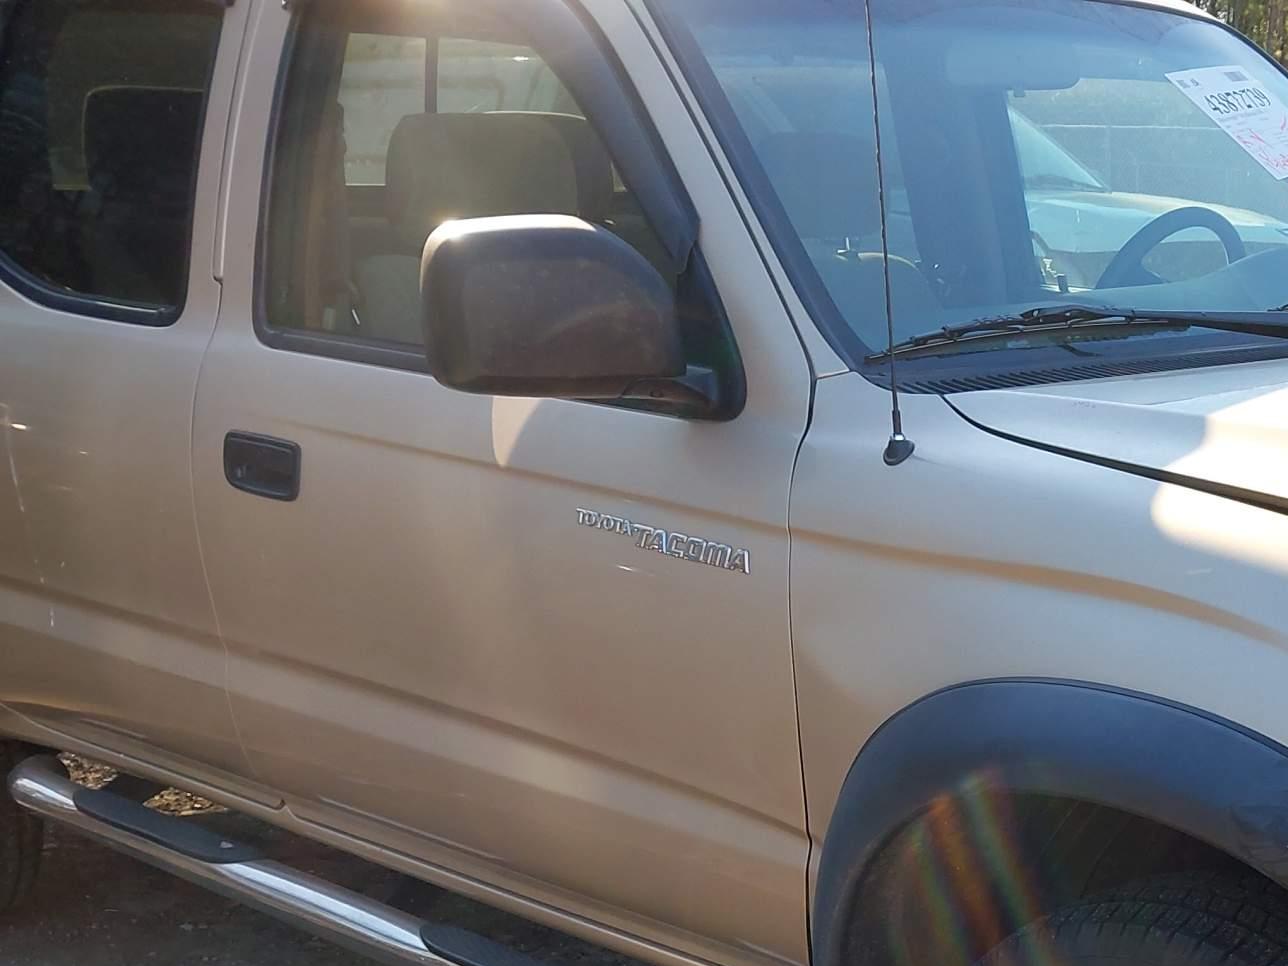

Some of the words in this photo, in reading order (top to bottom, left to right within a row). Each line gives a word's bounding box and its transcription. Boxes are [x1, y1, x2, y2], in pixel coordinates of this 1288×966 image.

[1204, 87, 1272, 115] 43872739
[576, 507, 633, 536] TOYOTA
[631, 523, 751, 575] TACOMA
